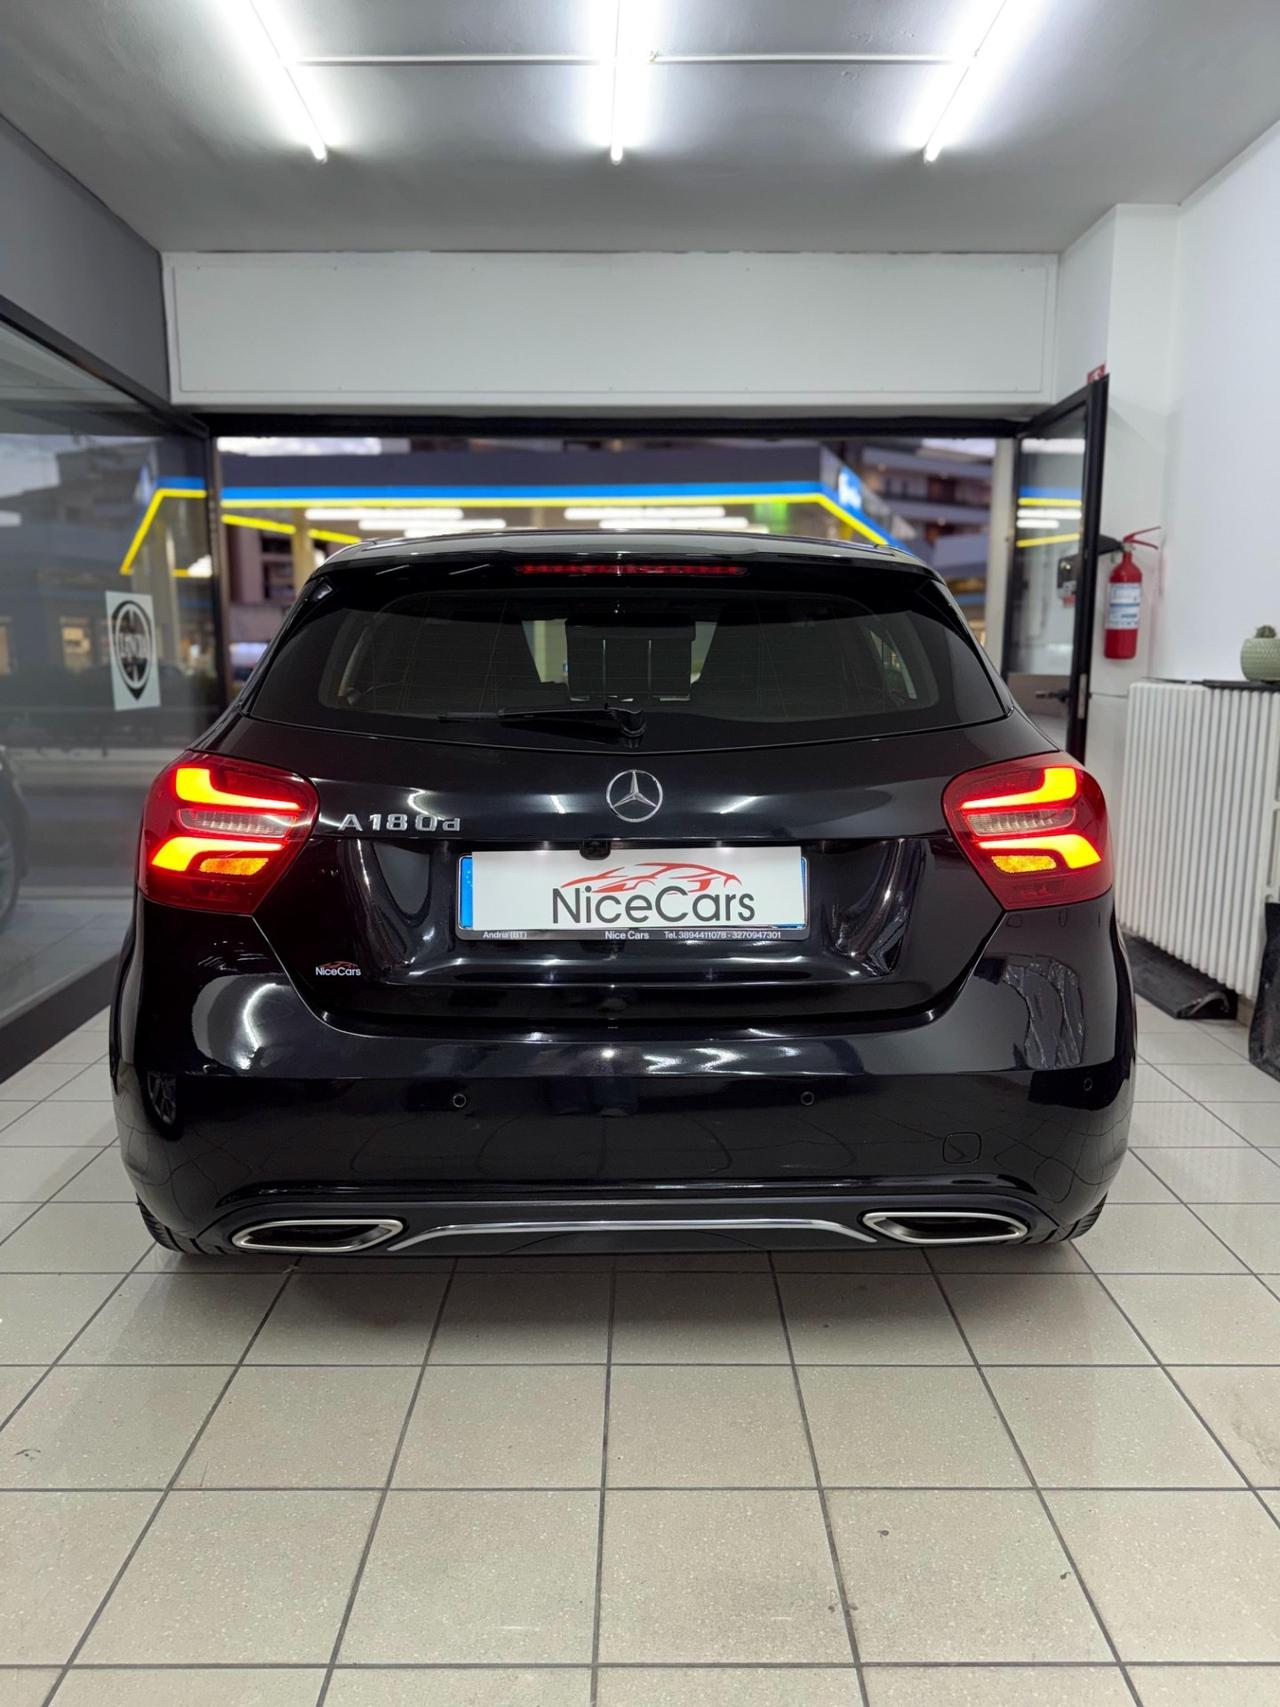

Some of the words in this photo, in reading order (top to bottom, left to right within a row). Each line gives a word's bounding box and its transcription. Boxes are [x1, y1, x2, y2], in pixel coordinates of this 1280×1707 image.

[552, 885, 756, 924] NiceCars
[604, 930, 626, 940] Nice
[627, 930, 650, 940] Cars
[664, 931, 678, 939] Tel.
